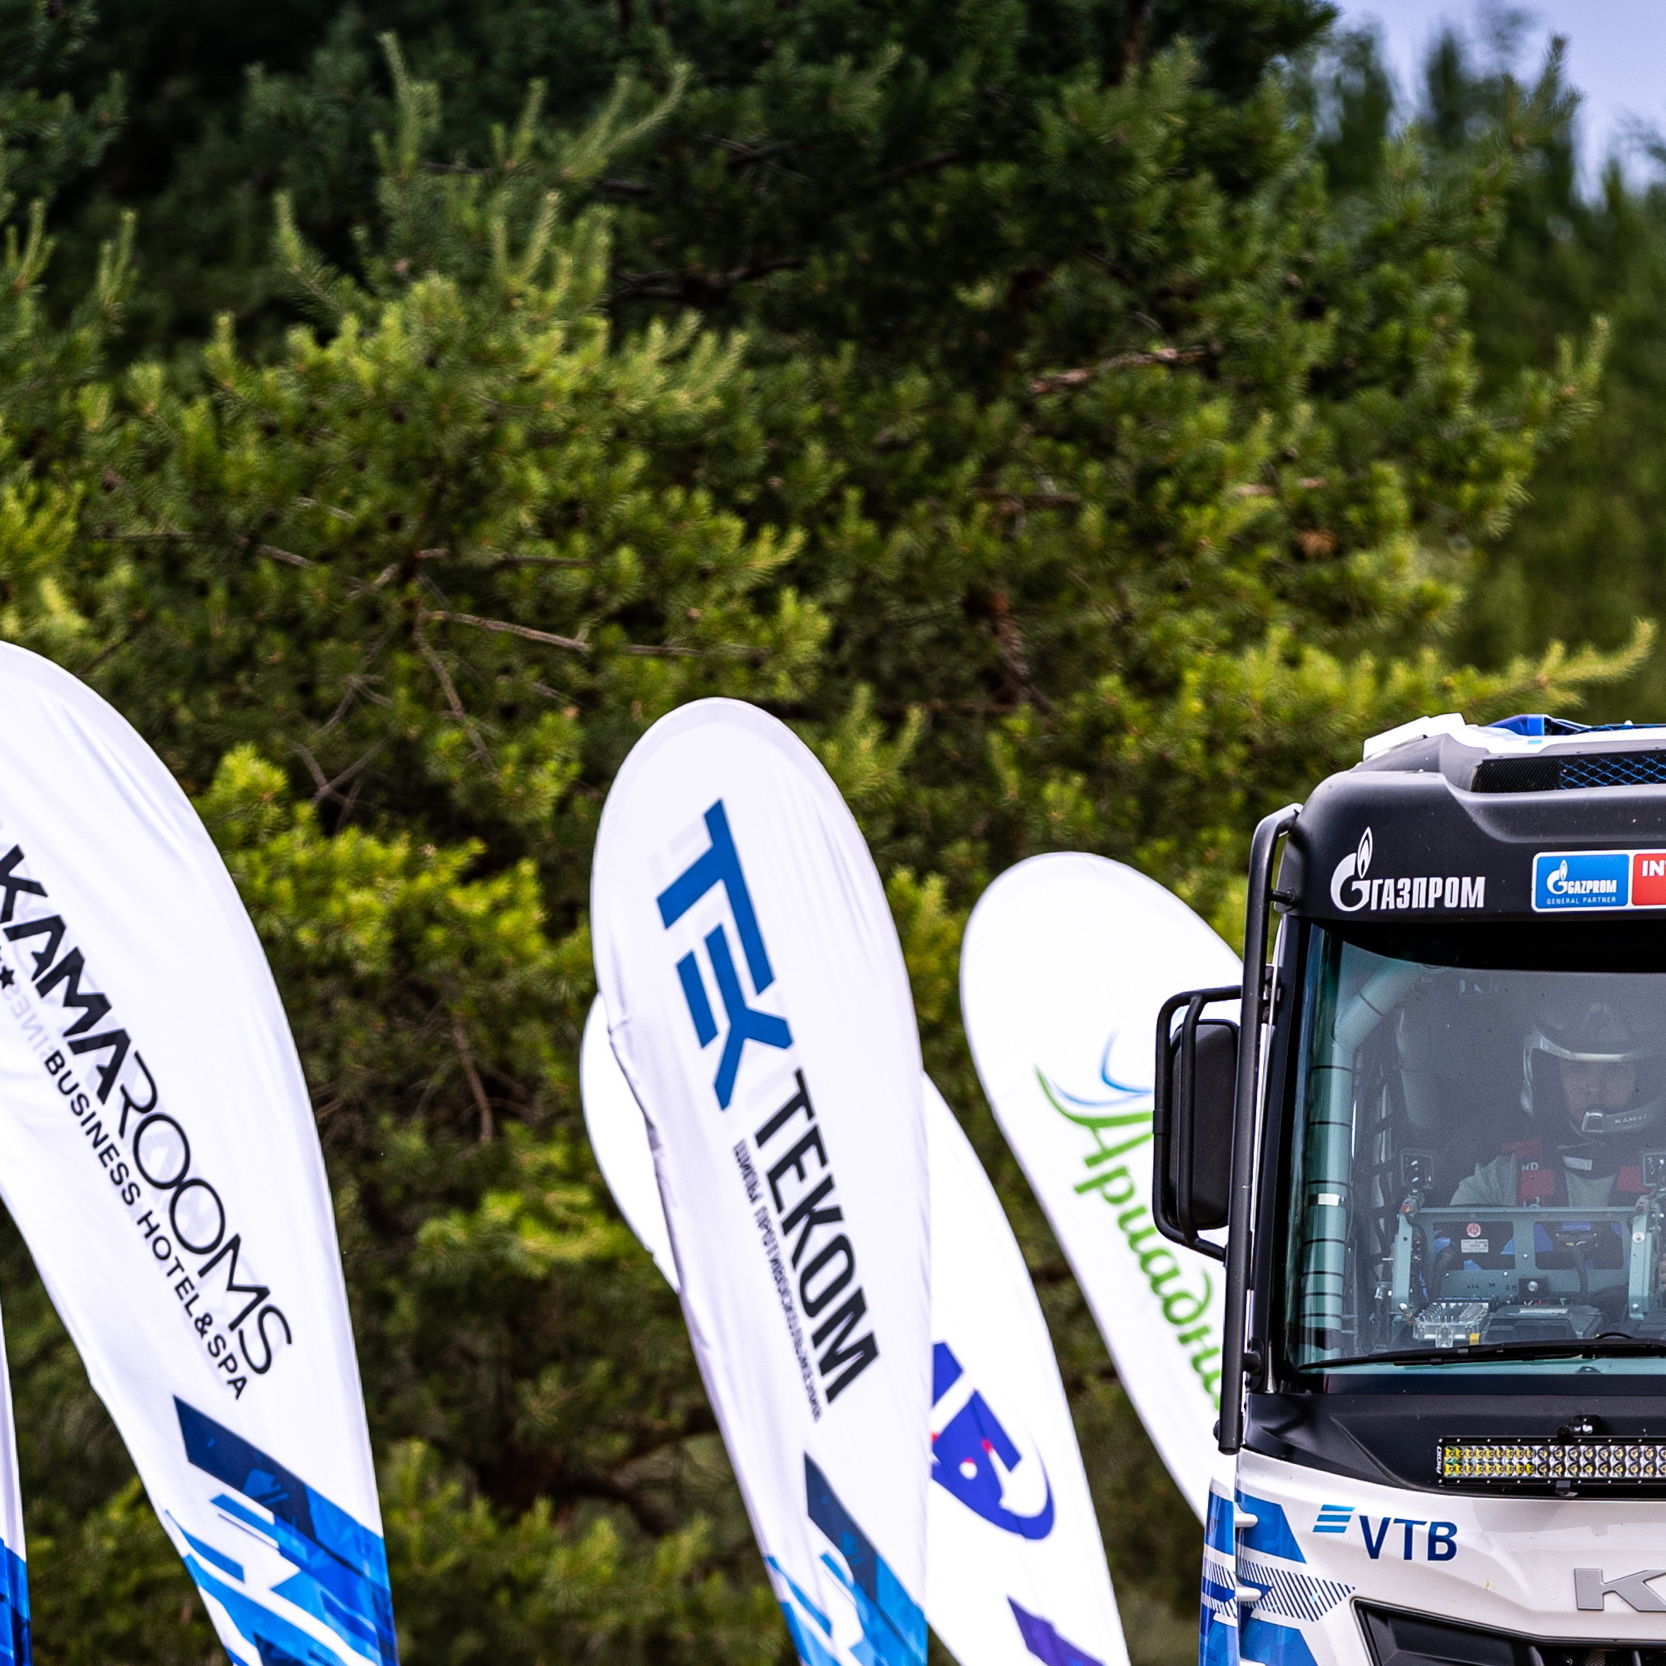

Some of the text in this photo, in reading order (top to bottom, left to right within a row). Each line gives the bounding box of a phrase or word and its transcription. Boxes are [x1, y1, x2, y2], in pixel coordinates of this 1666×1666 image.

[1370, 876, 1486, 910] ГАЗПРОМ
[1546, 896, 1617, 906] GENERAL PARTNER
[1567, 879, 1618, 895] GAZPROM
[42, 1049, 249, 1400] BUSINESS HOTEL&SPA
[754, 1066, 881, 1404] ТЕКОМ
[1358, 1514, 1458, 1562] VTB
